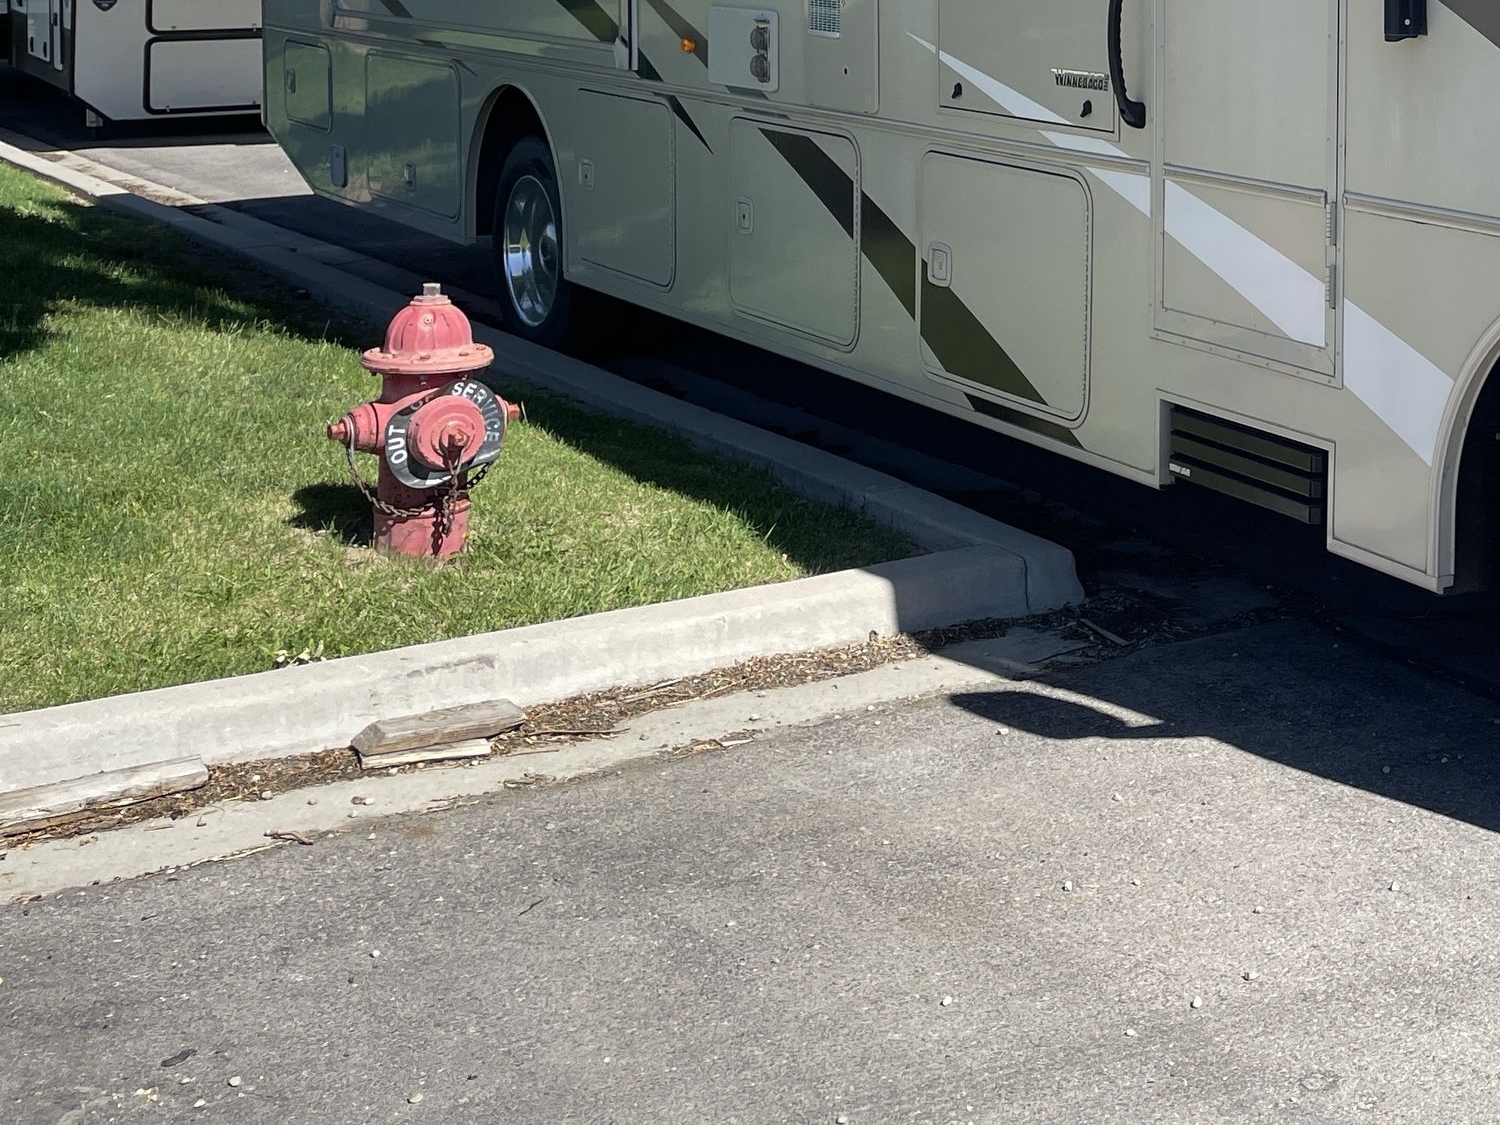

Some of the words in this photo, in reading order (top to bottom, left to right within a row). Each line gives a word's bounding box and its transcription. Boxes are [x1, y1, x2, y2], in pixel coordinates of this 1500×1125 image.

[1050, 68, 1104, 91] WINNEBAGO
[388, 425, 408, 464] OUT
[451, 382, 500, 441] SERVICE
